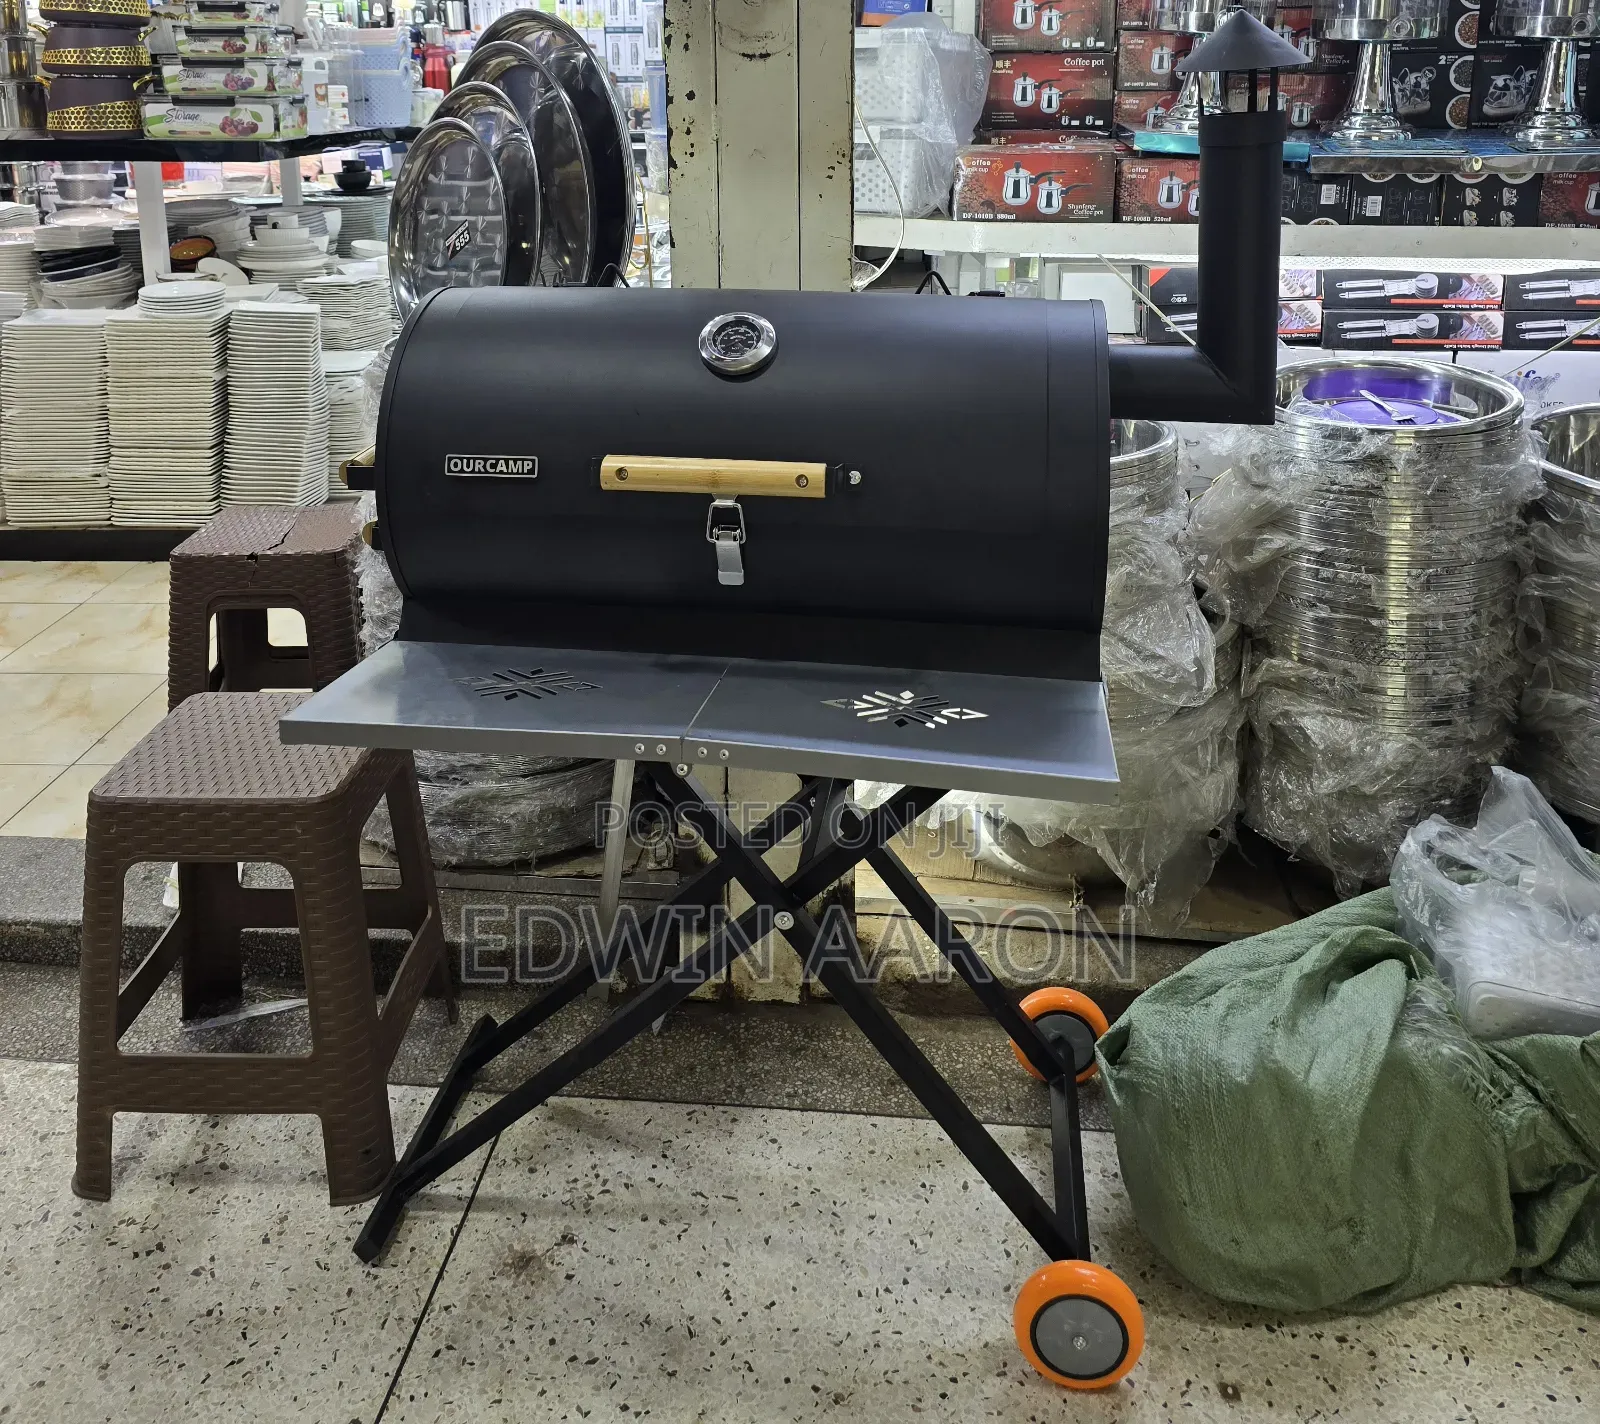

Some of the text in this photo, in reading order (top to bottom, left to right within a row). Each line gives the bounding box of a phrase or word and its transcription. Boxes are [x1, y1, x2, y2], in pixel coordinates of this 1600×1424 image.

[1064, 58, 1104, 67] Coffee pot
[1437, 54, 1446, 64] 2
[163, 108, 200, 123] Storage
[964, 156, 991, 166] Coffee
[1125, 164, 1149, 173] Coffee
[455, 229, 470, 251] 555
[449, 458, 533, 473] OURCAMP
